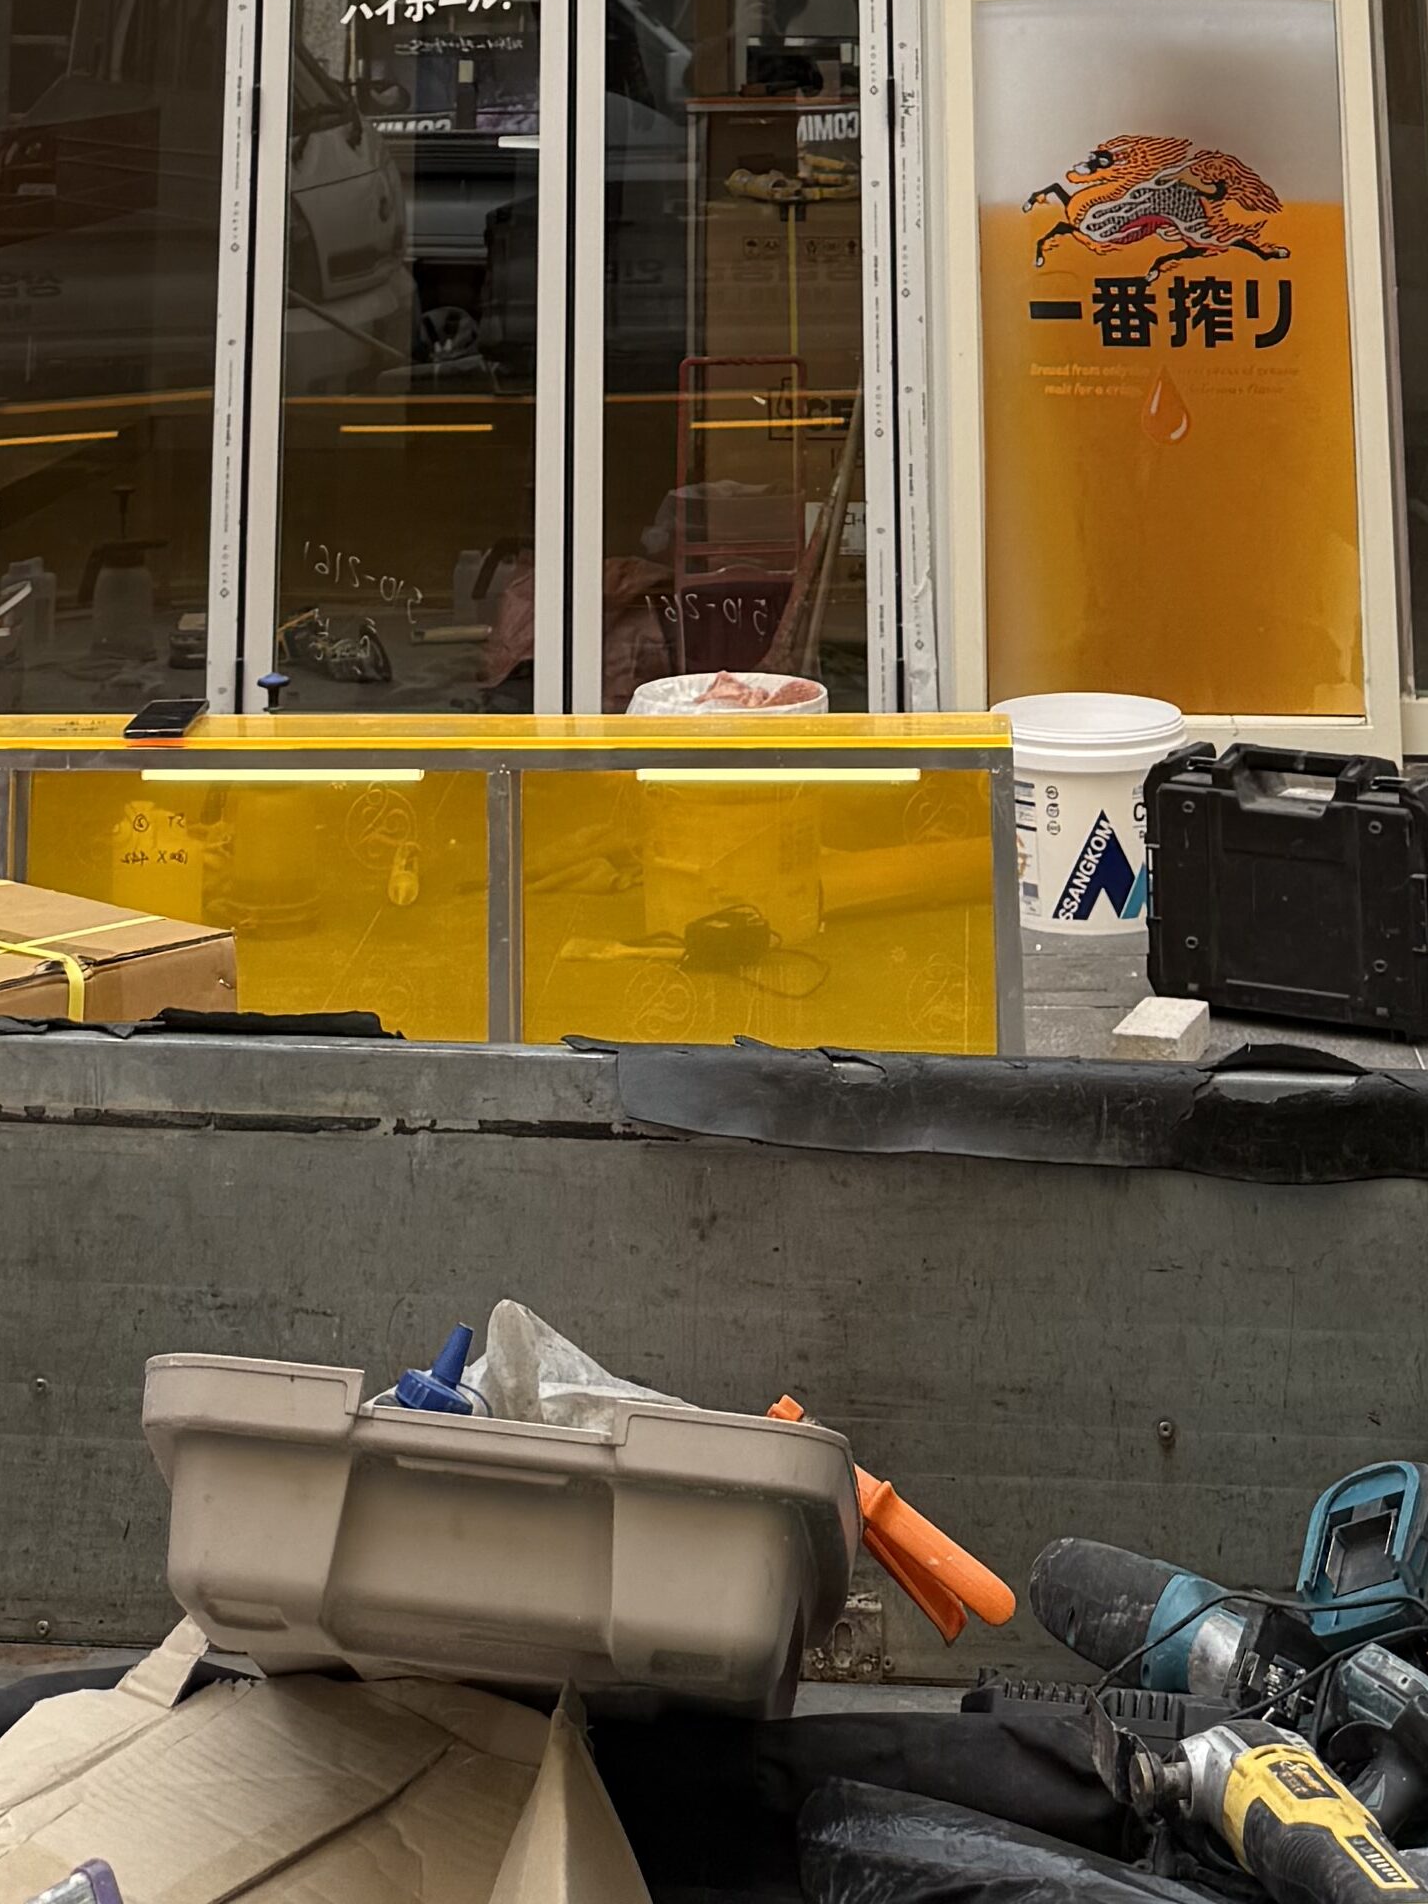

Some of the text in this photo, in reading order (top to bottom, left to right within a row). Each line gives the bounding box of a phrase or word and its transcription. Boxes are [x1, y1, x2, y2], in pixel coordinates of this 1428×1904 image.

[1029, 276, 1293, 348] 一番搾り
[1058, 819, 1113, 921] SSANGKOM
